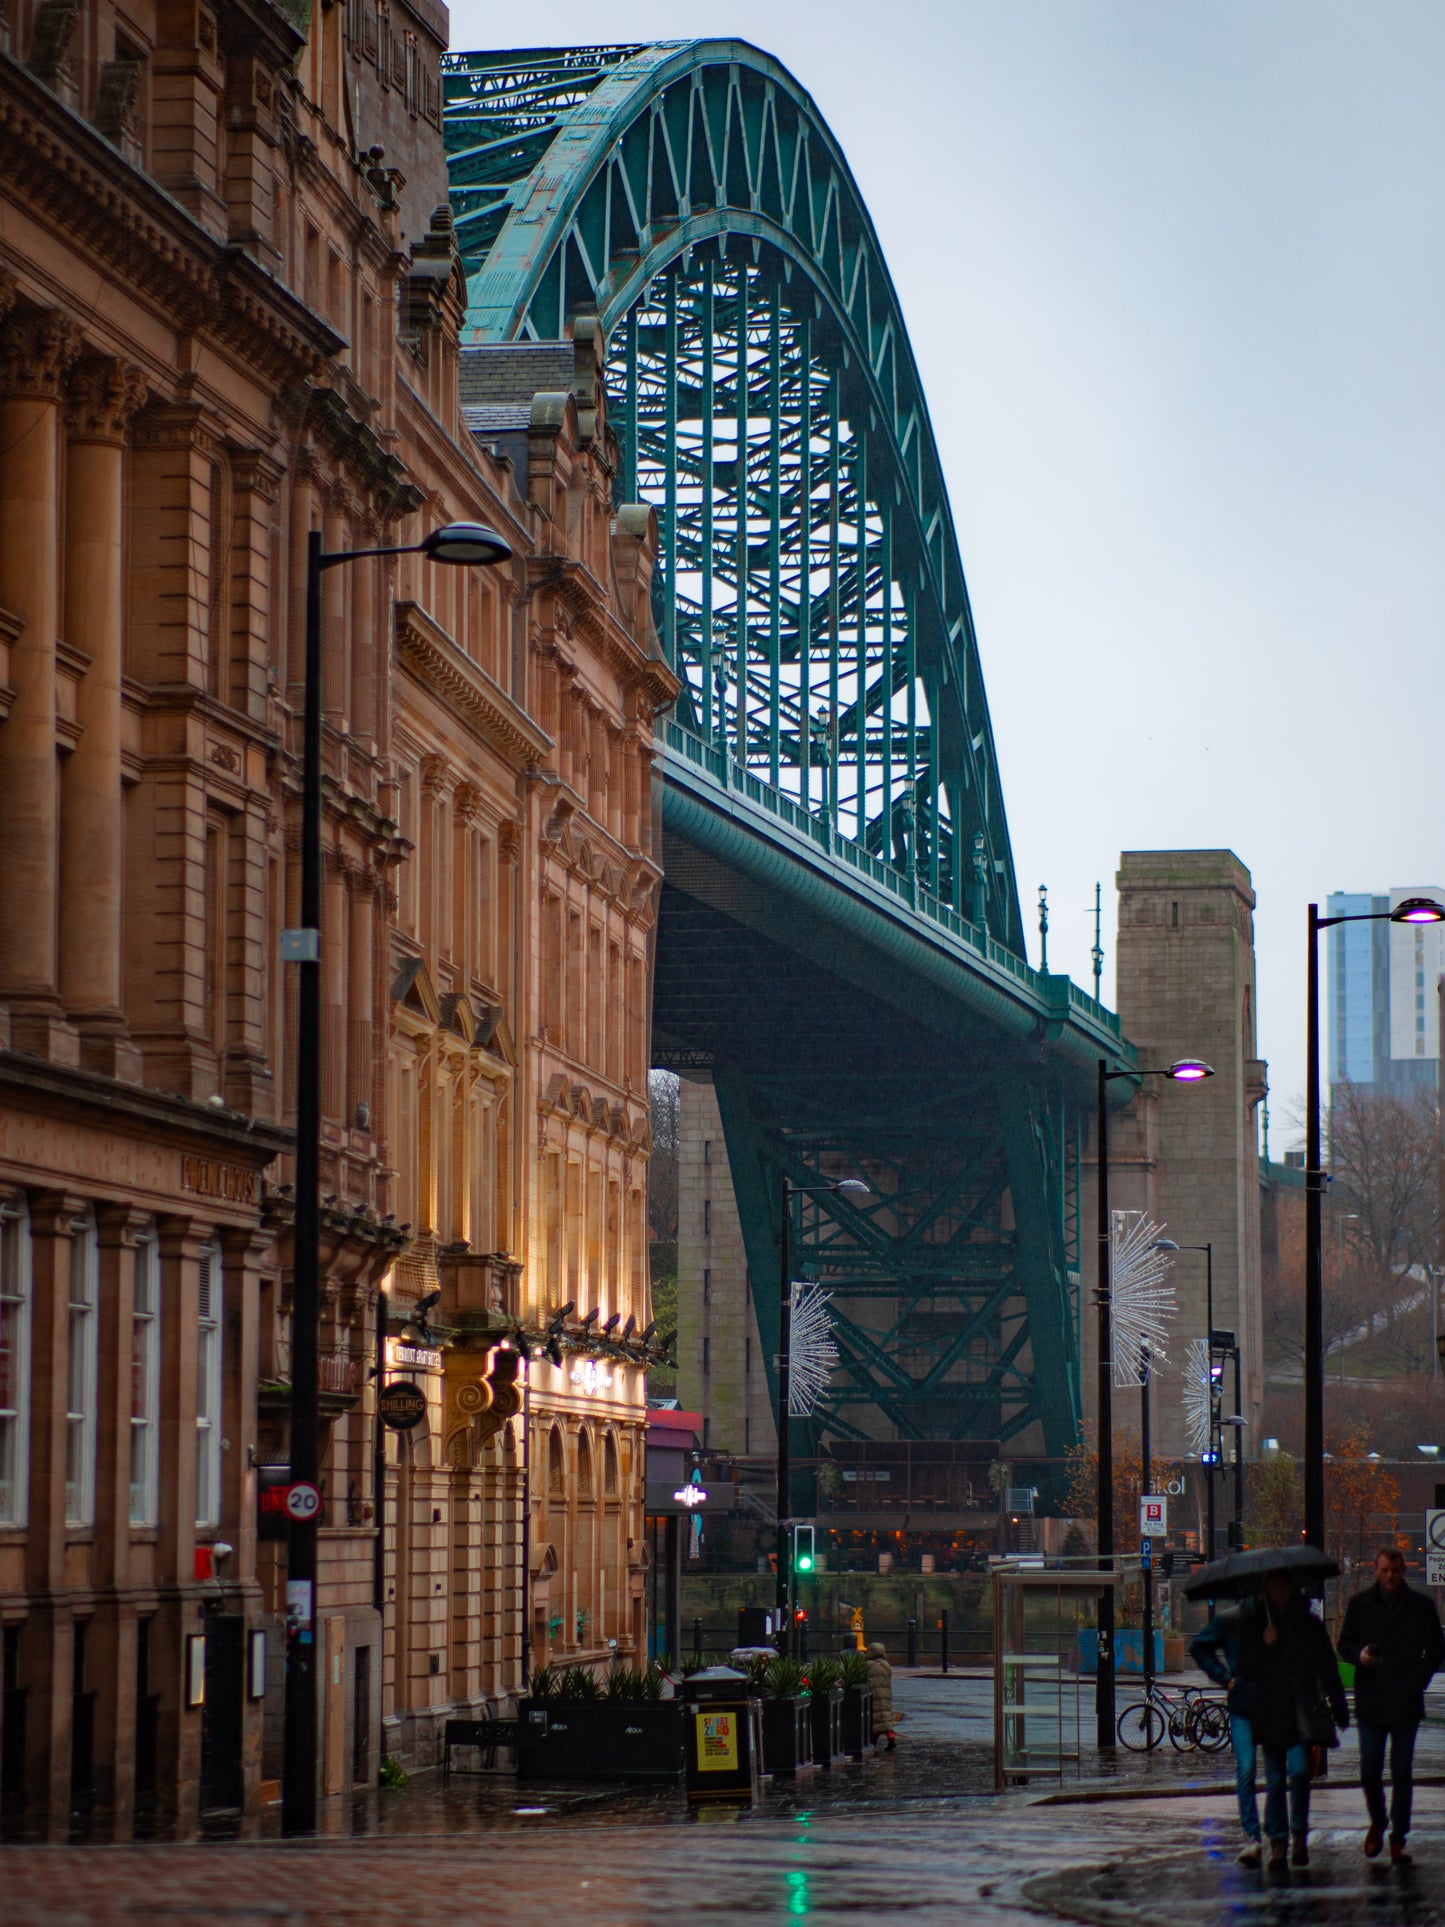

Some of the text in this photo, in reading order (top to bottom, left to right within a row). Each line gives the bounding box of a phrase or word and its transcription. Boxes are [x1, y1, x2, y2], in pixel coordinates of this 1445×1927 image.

[380, 1398, 424, 1411] SHILLING
[290, 1492, 316, 1509] 20
[1149, 1505, 1158, 1516] B
[1143, 1541, 1150, 1555] P
[704, 1717, 728, 1725] STREET
[704, 1725, 729, 1736] ZERO
